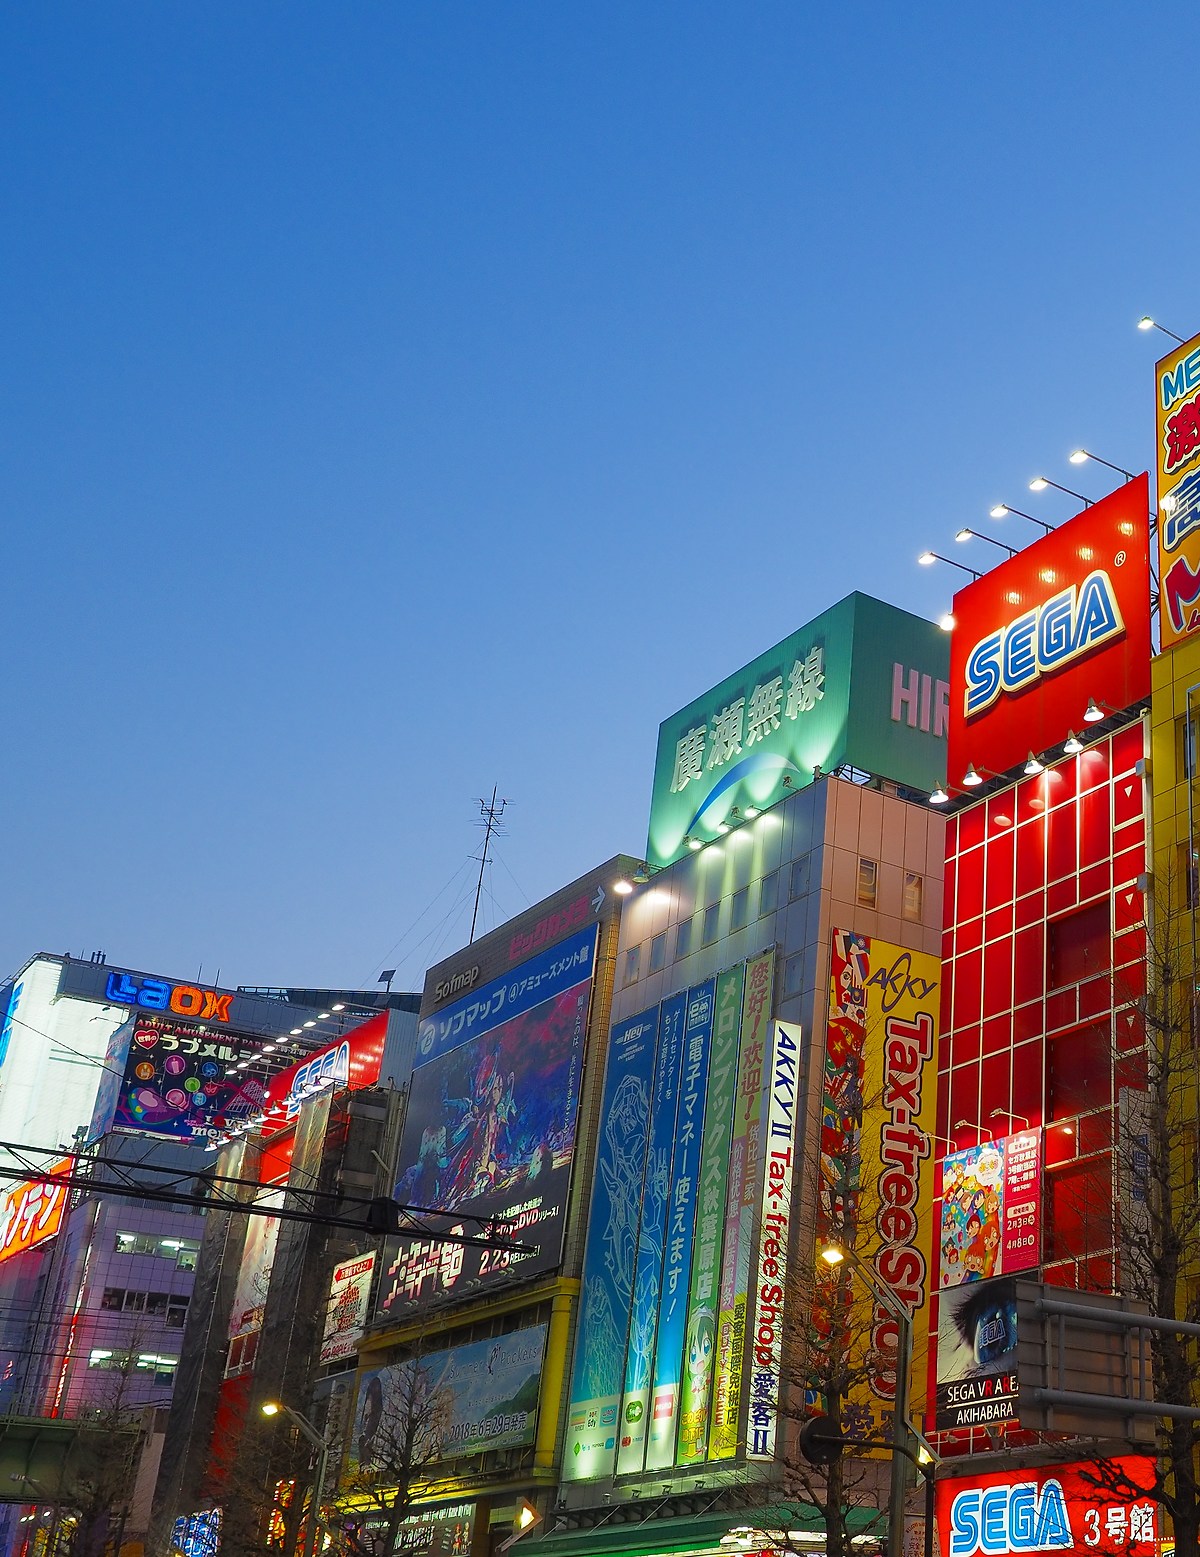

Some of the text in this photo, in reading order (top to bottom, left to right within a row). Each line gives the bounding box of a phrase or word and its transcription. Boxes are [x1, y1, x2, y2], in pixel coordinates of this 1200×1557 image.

[964, 569, 1126, 718] SEGA
[509, 895, 590, 960] ビックカメラ
[433, 965, 479, 1003] Sofmap
[866, 967, 938, 1000] AKKY
[137, 1019, 173, 1032] ADULT
[440, 985, 508, 1041] ソフマップ
[624, 1025, 642, 1044] Hey
[664, 1008, 681, 1100] ゲームセンターを
[774, 1026, 798, 1121] AKKY
[695, 977, 738, 1300] メロンブックス秋葉原店
[666, 1034, 705, 1322] 電子マネー使えます!
[947, 1376, 1019, 1403] SEGA VR ARE
[956, 1402, 1014, 1425] AKIHABARA
[450, 1410, 528, 1442] 2018年6月29日発売
[950, 1478, 1075, 1557] SEGA
[1084, 1503, 1155, 1547] 3号館
